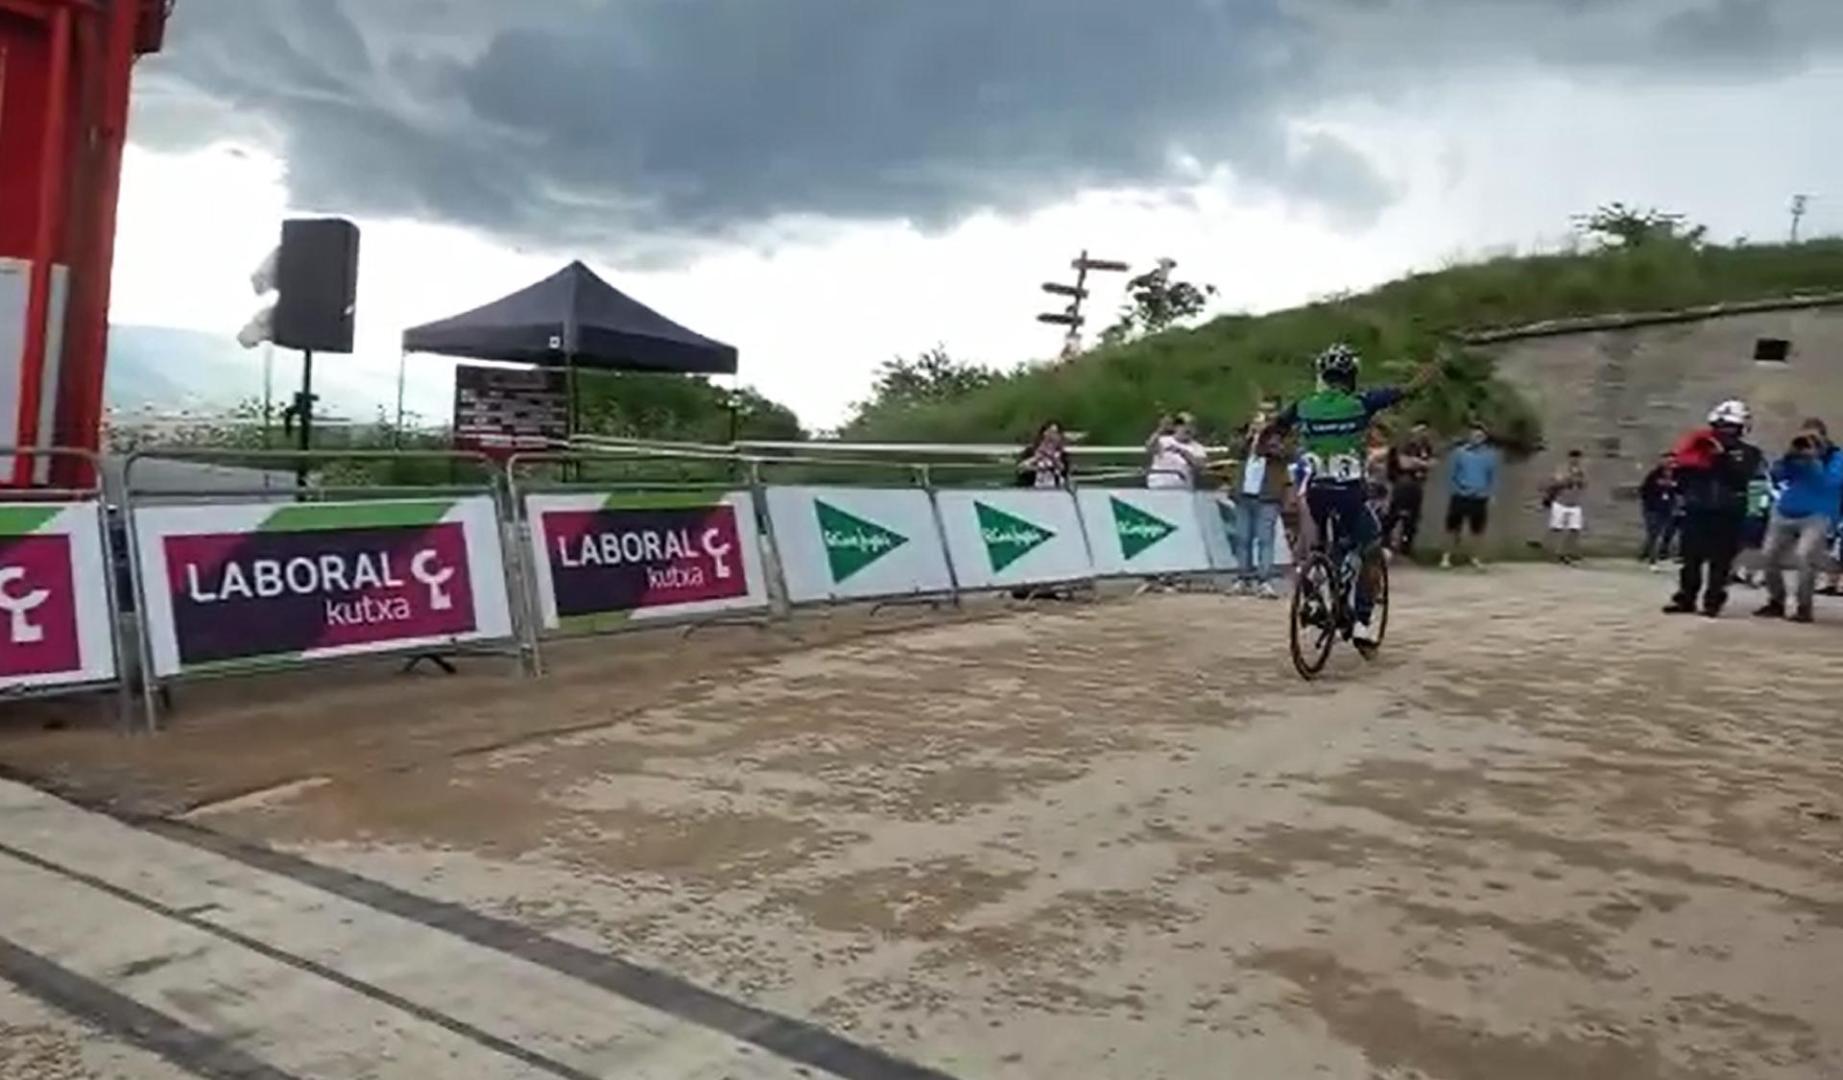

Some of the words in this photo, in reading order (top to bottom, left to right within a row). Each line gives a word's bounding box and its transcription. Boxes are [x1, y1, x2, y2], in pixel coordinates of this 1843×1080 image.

[558, 529, 699, 567] LABORAL
[187, 552, 404, 602] LABORAL
[646, 565, 704, 588] kutxa
[326, 595, 411, 625] kutxa
